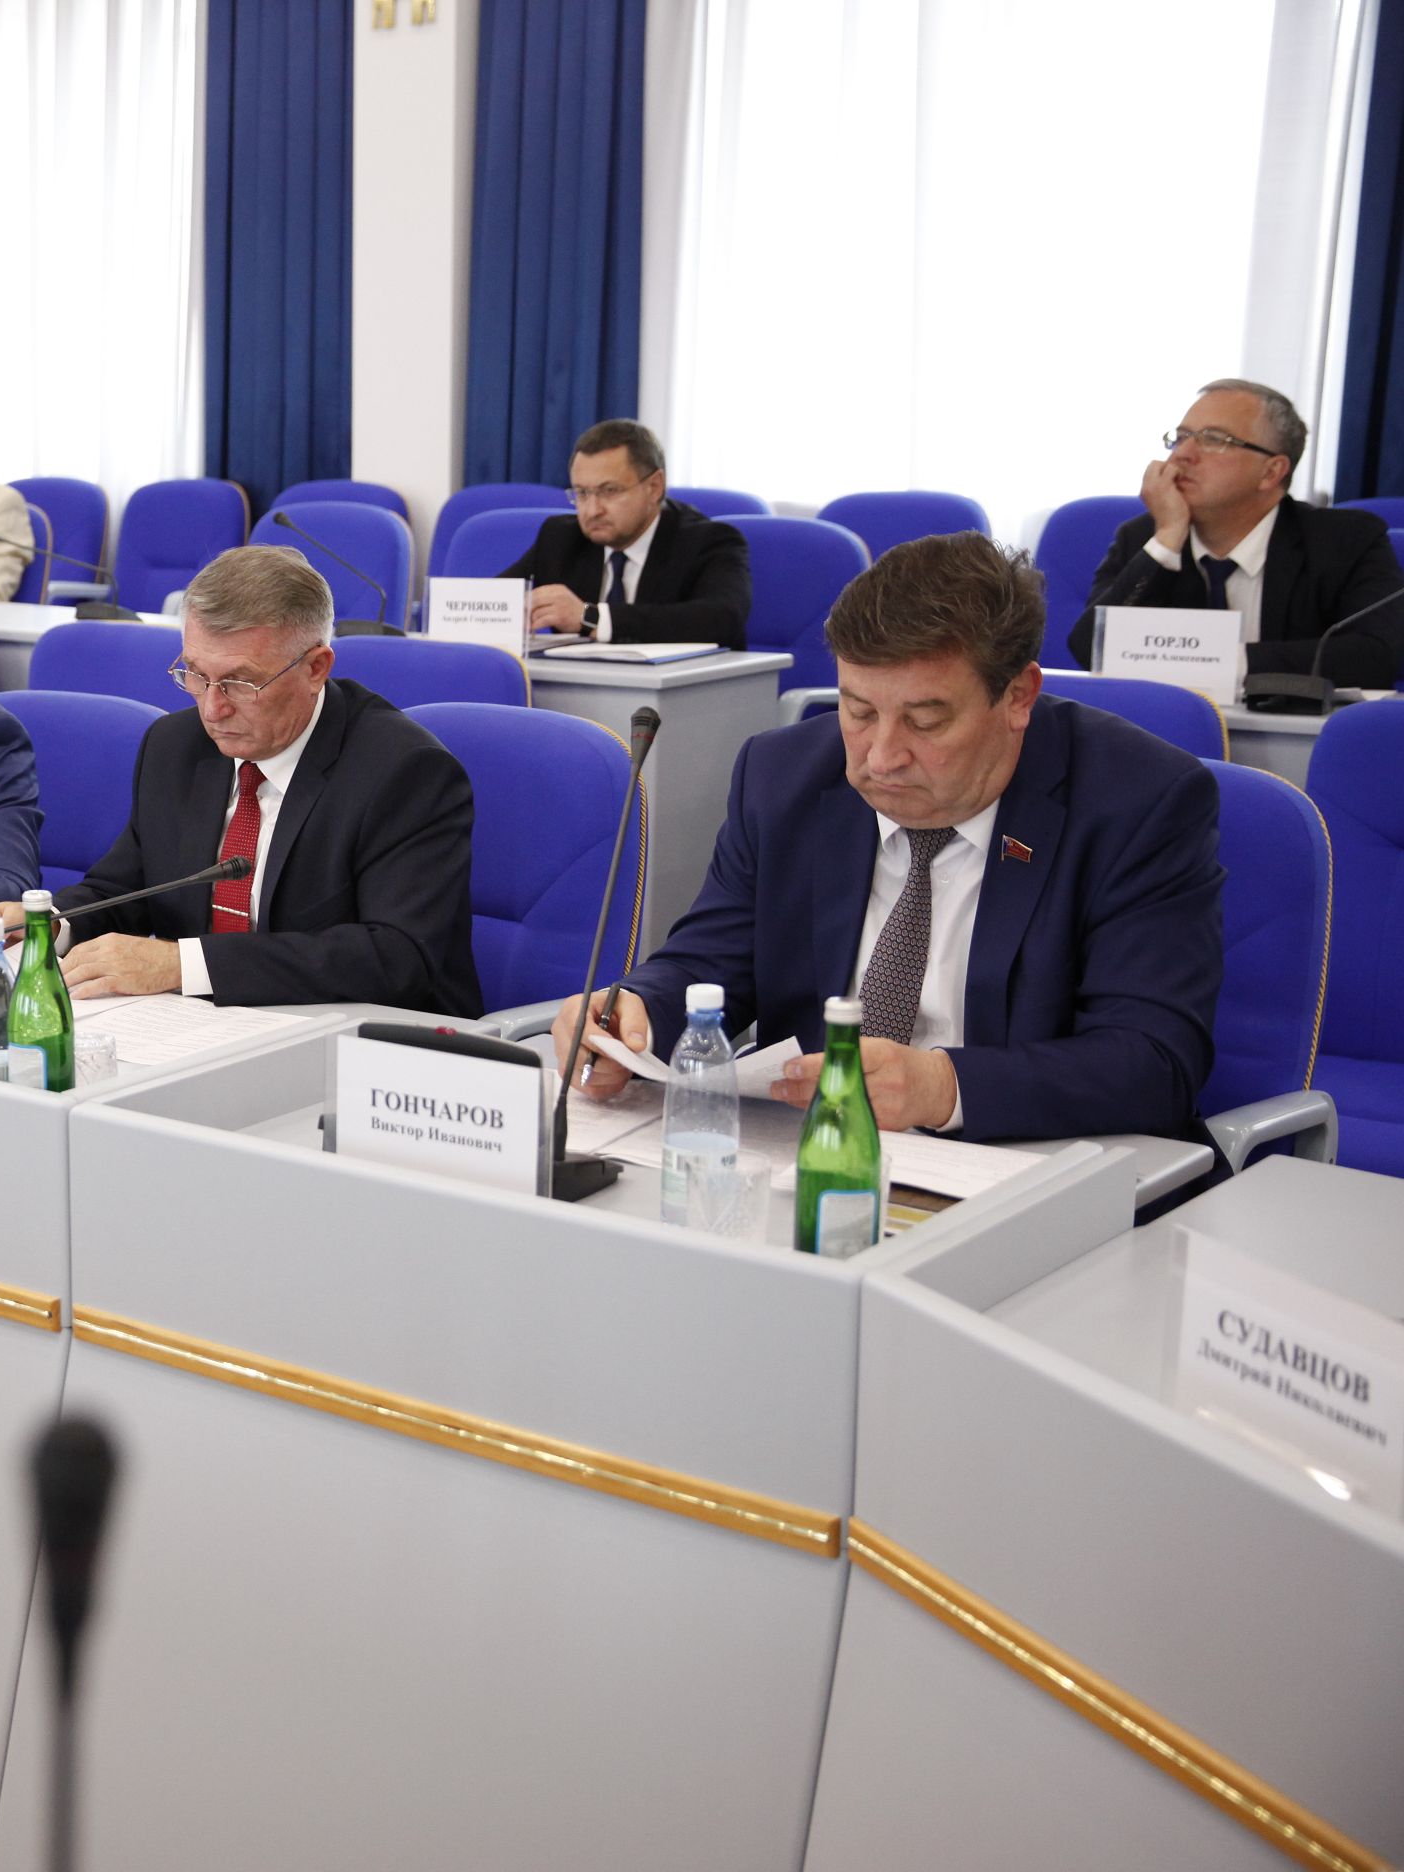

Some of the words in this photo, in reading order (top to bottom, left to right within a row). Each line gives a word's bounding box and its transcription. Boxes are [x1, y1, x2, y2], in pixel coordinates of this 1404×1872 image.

[446, 600, 508, 612] ЧЕРНЯКОВ
[1144, 635, 1200, 649] ГОРЛО
[1121, 651, 1157, 663] Сергей
[369, 1088, 505, 1129] ГОНЧАРОВ
[370, 1116, 424, 1141] Виктор
[427, 1127, 503, 1153] Иванович
[1216, 1309, 1371, 1404] СУДАВЦОВ
